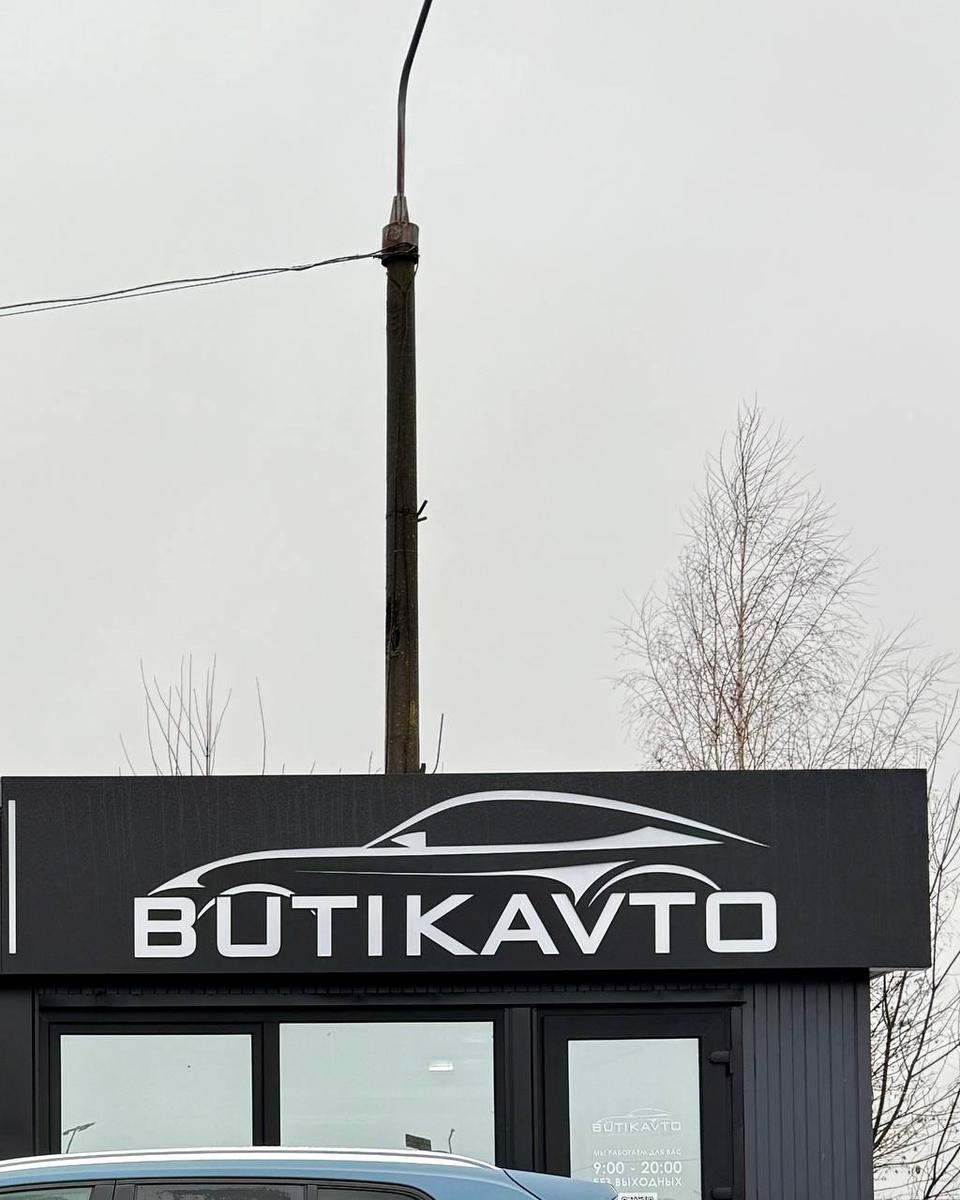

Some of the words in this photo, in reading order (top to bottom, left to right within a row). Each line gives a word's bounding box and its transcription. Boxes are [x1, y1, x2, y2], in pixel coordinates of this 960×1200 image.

[134, 891, 778, 958] BUTIKAVTO
[592, 1121, 681, 1132] BUTIKAVTO
[593, 1161, 625, 1175] 9:00
[640, 1160, 683, 1174] 20:00
[615, 1176, 683, 1188] ВЫХОДНЫХ
